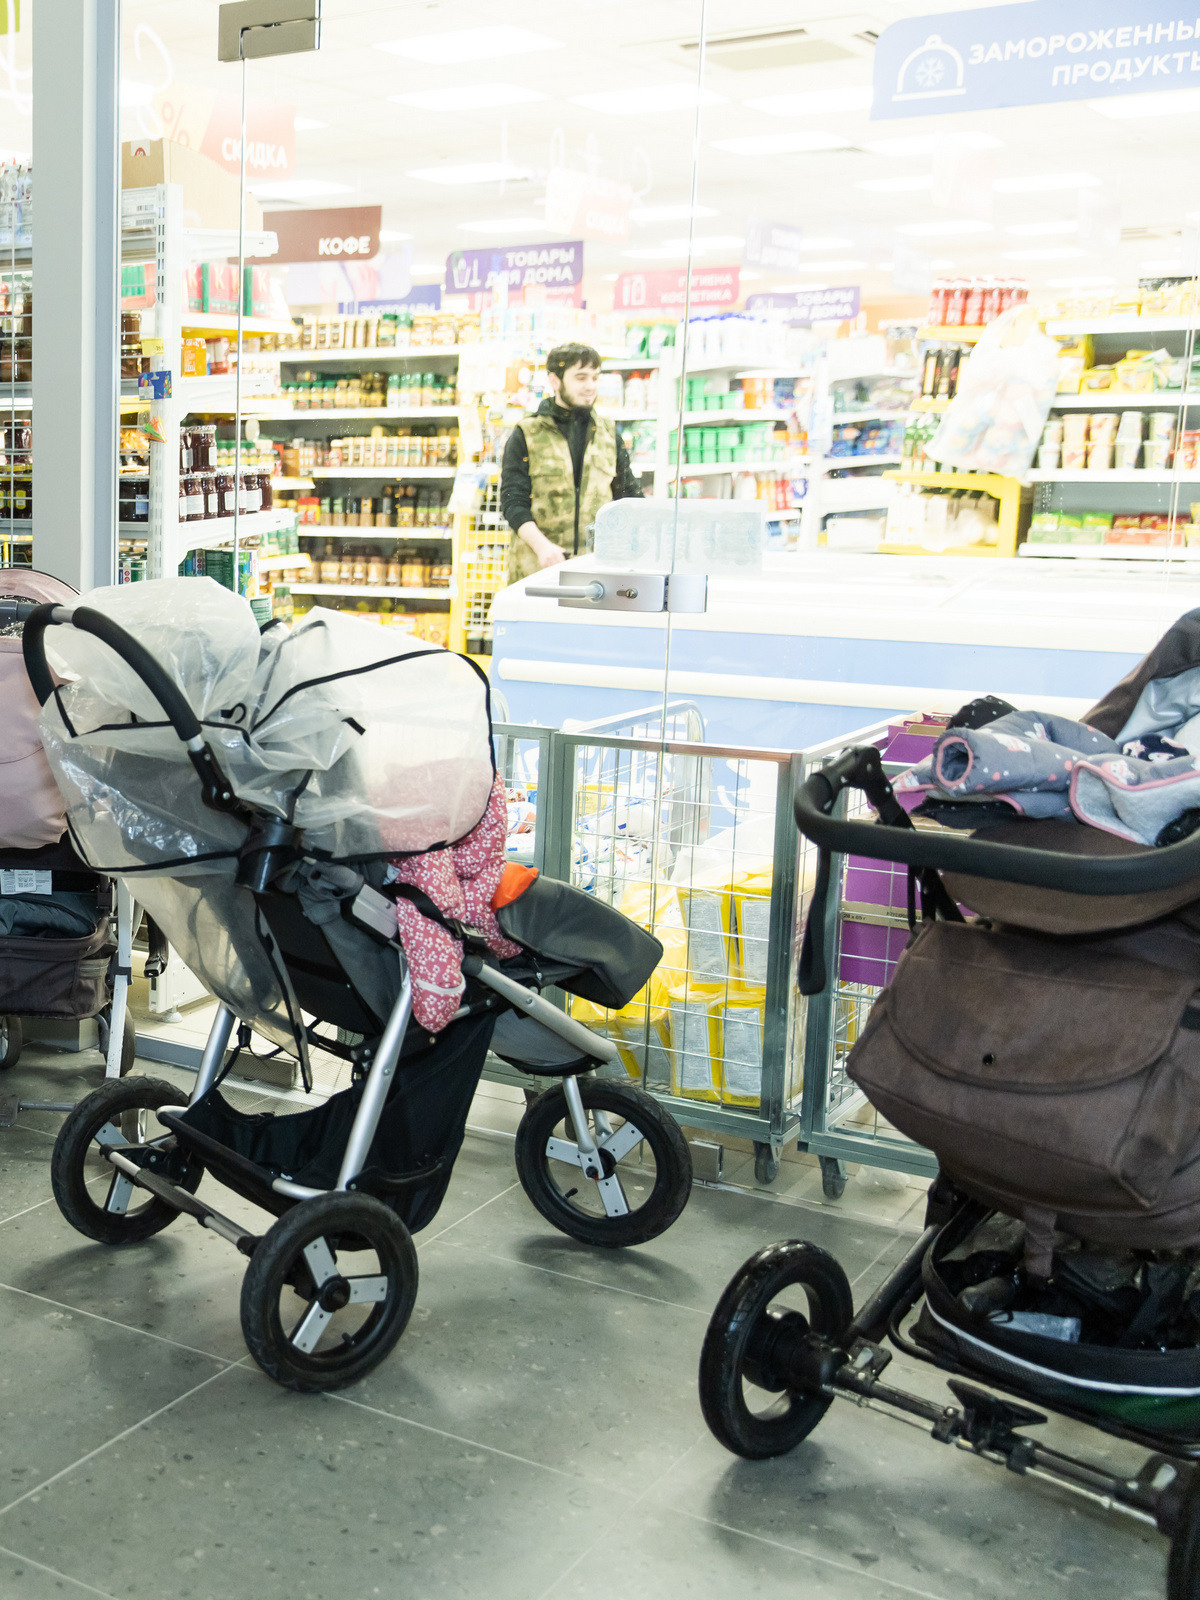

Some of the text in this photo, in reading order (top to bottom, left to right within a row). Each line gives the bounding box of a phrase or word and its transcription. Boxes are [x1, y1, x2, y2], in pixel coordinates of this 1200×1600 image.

[221, 137, 287, 170] СКИДКА
[318, 235, 371, 256] КОФЕ
[506, 246, 576, 268] ТОВАРЫ
[522, 264, 574, 286] ДОМА
[795, 289, 855, 306] ТОВАРЫ
